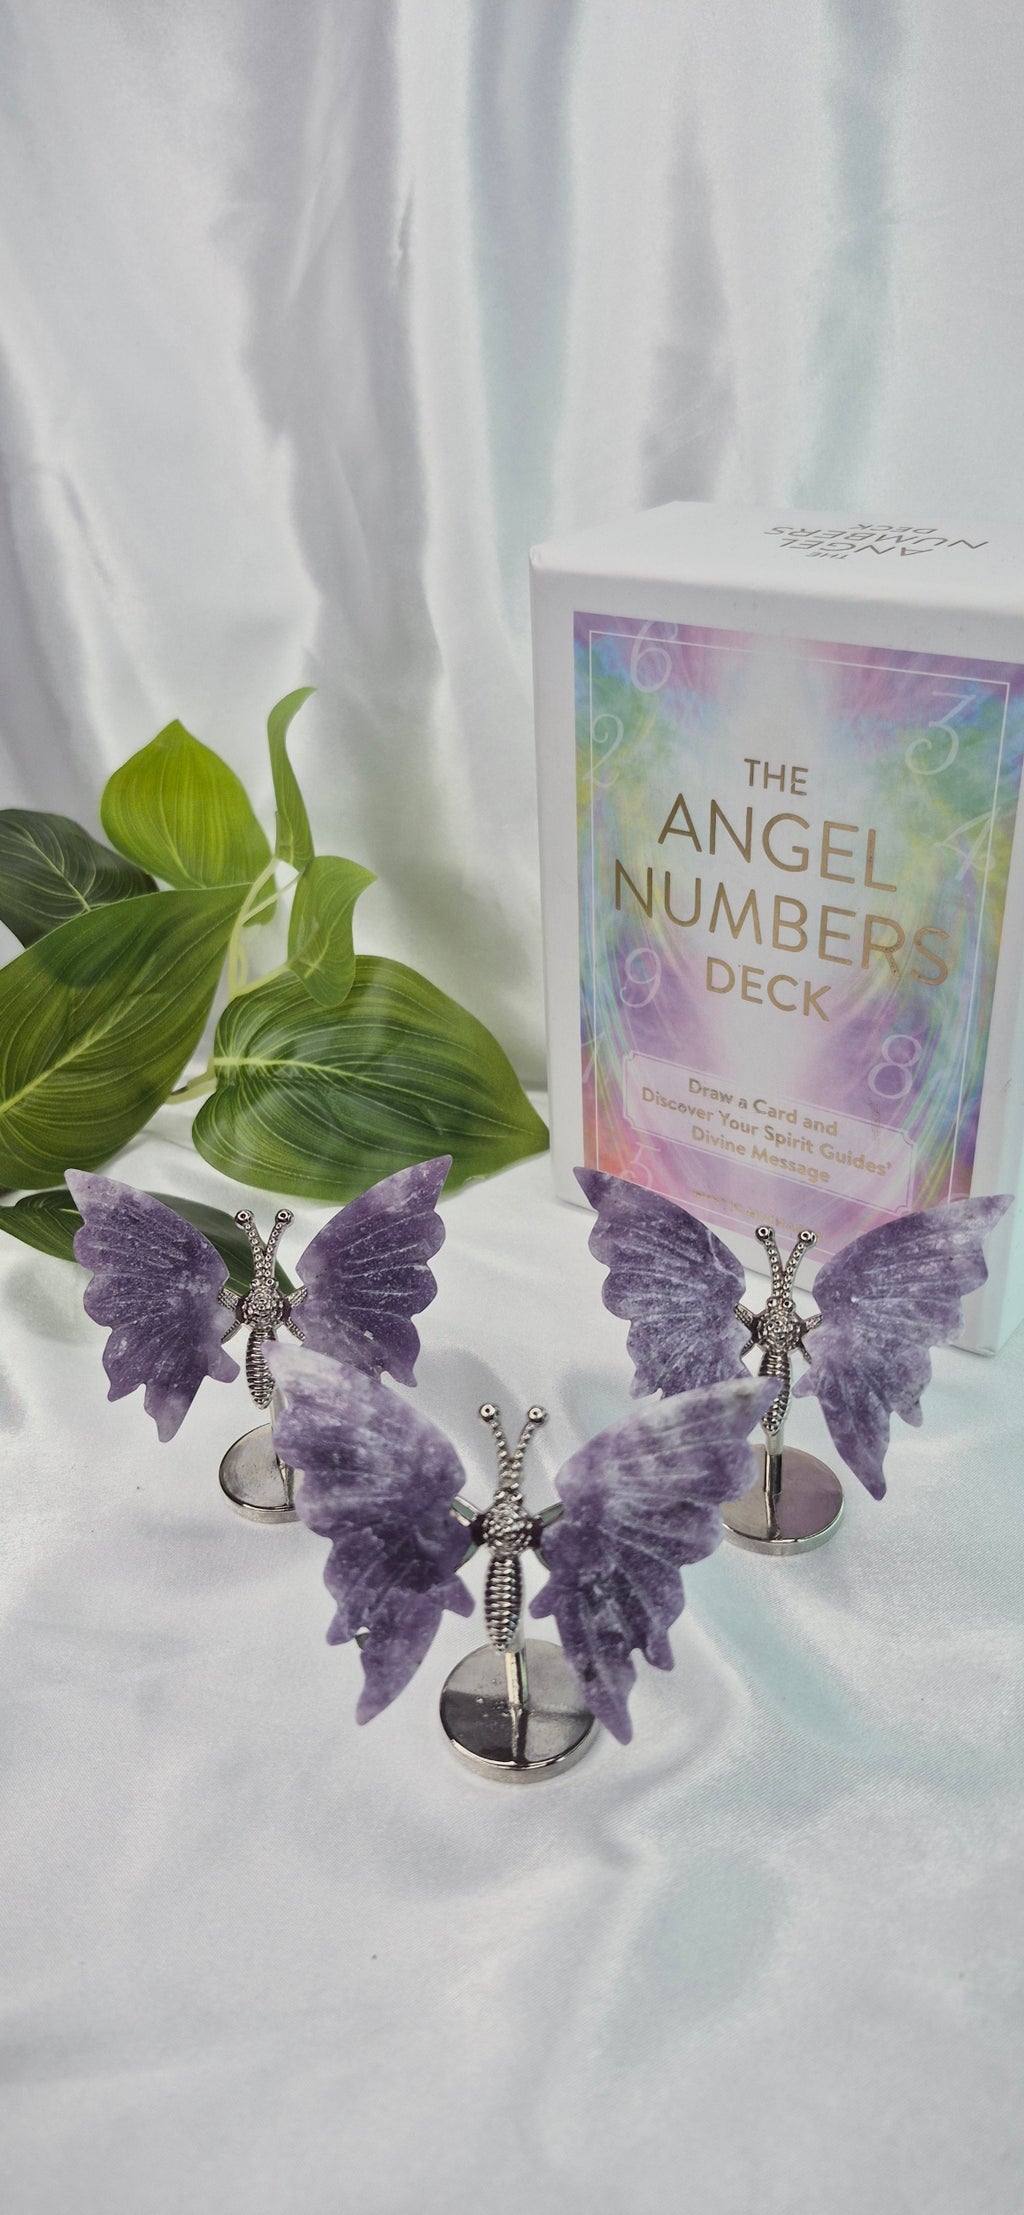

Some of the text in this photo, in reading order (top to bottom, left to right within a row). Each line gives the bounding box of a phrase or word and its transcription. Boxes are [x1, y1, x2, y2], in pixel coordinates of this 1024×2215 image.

[763, 526, 989, 549] NUMBERS
[779, 538, 934, 557] ANGEL
[806, 551, 849, 559] THE
[851, 523, 938, 535] DECK
[744, 758, 809, 796] THE
[658, 793, 897, 892] ANGEL
[615, 858, 949, 986] NUMBERS
[706, 956, 832, 1022] DECK
[642, 1086, 714, 1121] Discover
[718, 1110, 759, 1136] Your
[764, 1124, 814, 1154] Spirit
[688, 1078, 838, 1137] Draw a Card and
[692, 1125, 831, 1183] Divine Message
